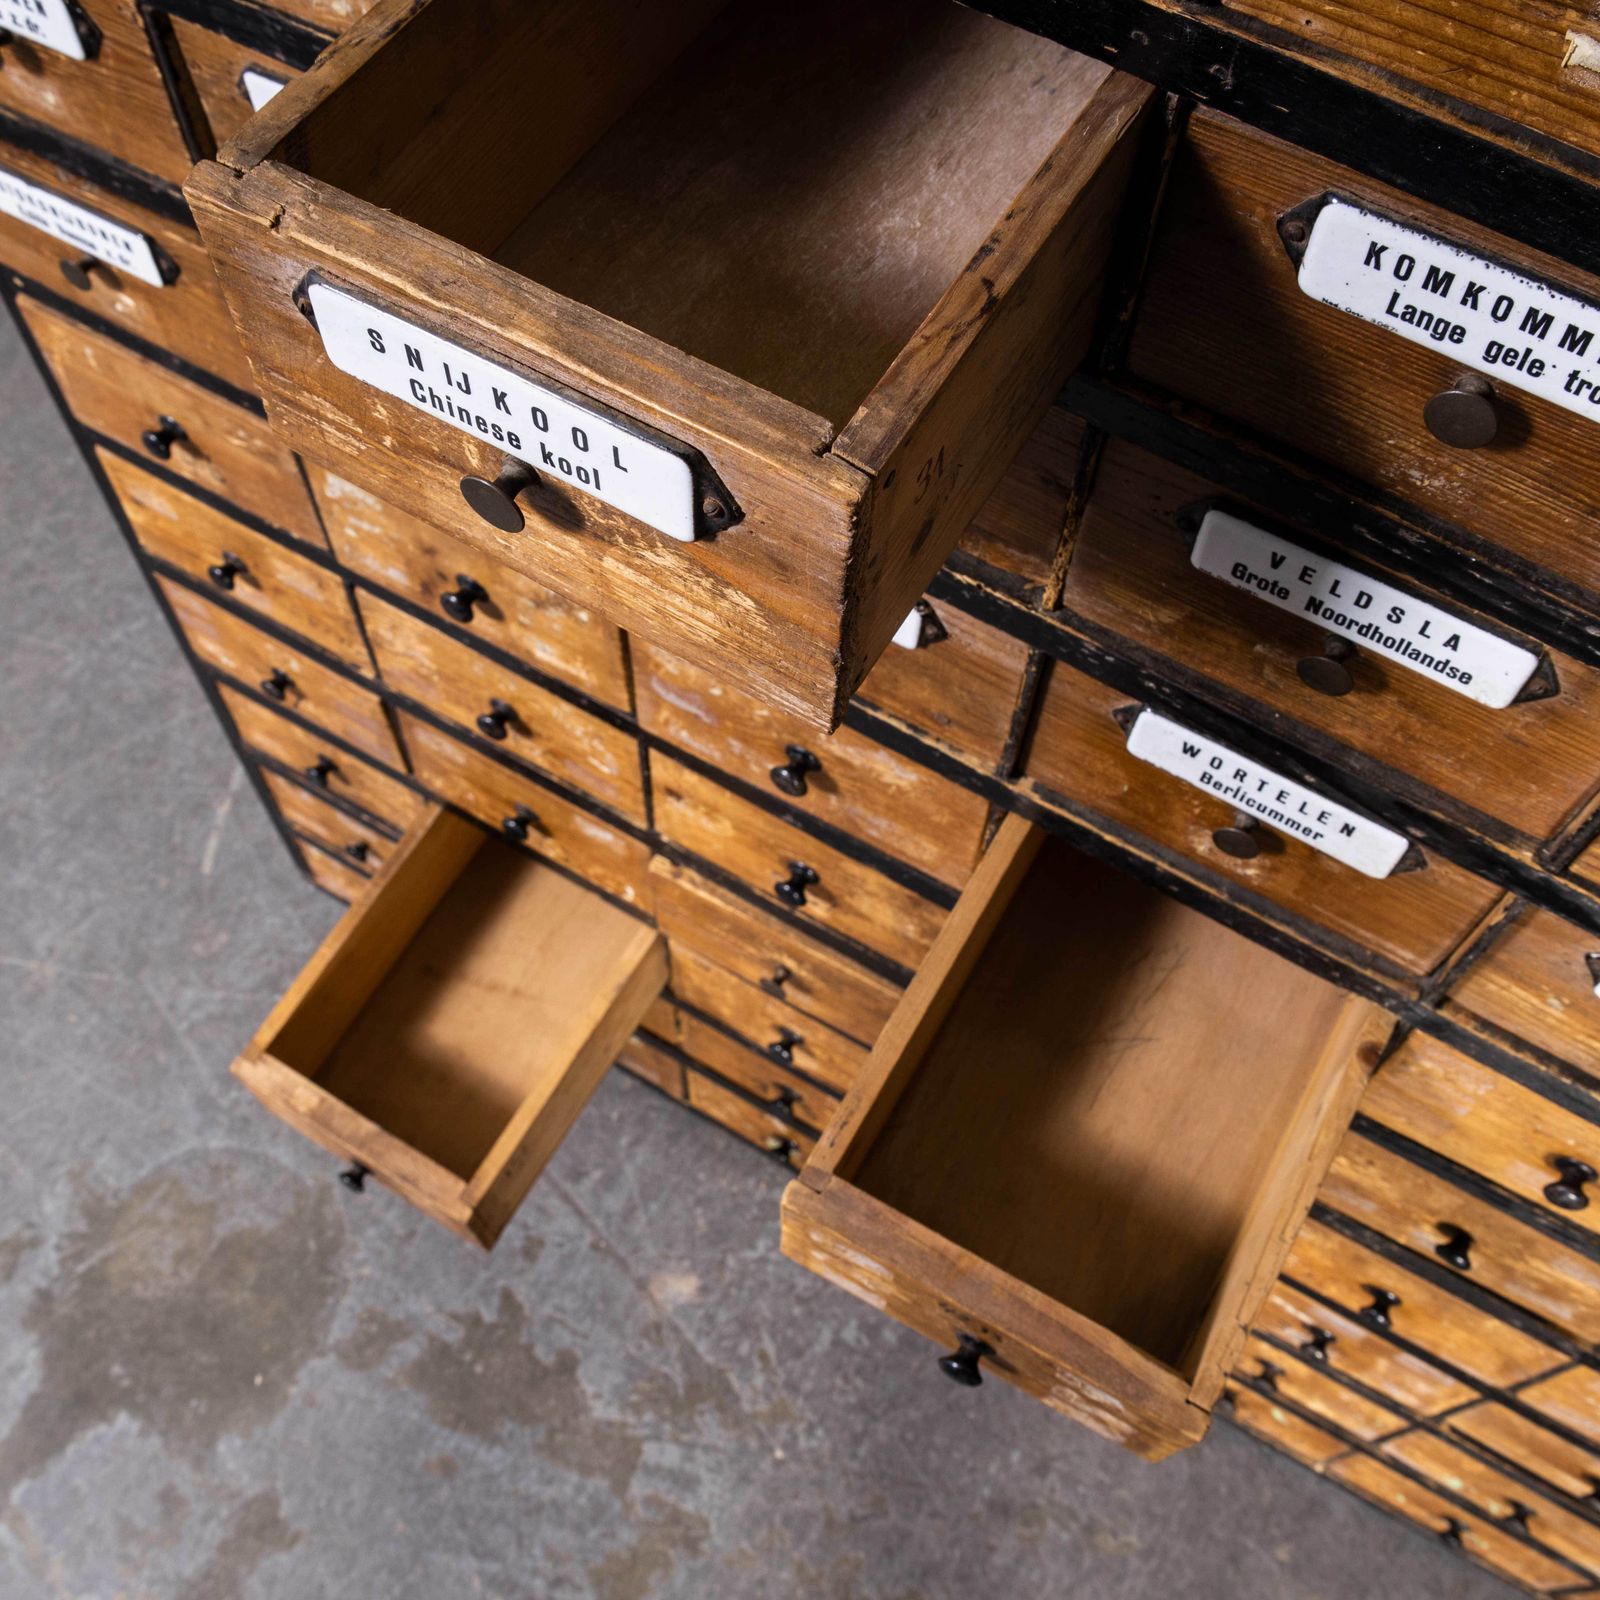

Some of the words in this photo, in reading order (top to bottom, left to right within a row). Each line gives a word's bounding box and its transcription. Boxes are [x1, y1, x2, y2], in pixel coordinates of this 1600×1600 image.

[1363, 240, 1600, 364] KOMKOMM
[1384, 290, 1467, 345] Lange
[1482, 338, 1547, 379] gele
[366, 327, 628, 473] SNIJKOOL
[410, 377, 522, 451] Chinese
[540, 441, 602, 492] kool
[1230, 562, 1291, 600] Grote
[1303, 595, 1473, 685] Noordhollandse
[1269, 551, 1462, 652] VELDSLA
[1181, 740, 1358, 838] WORTELEN
[1199, 771, 1326, 842] Berlicummer
